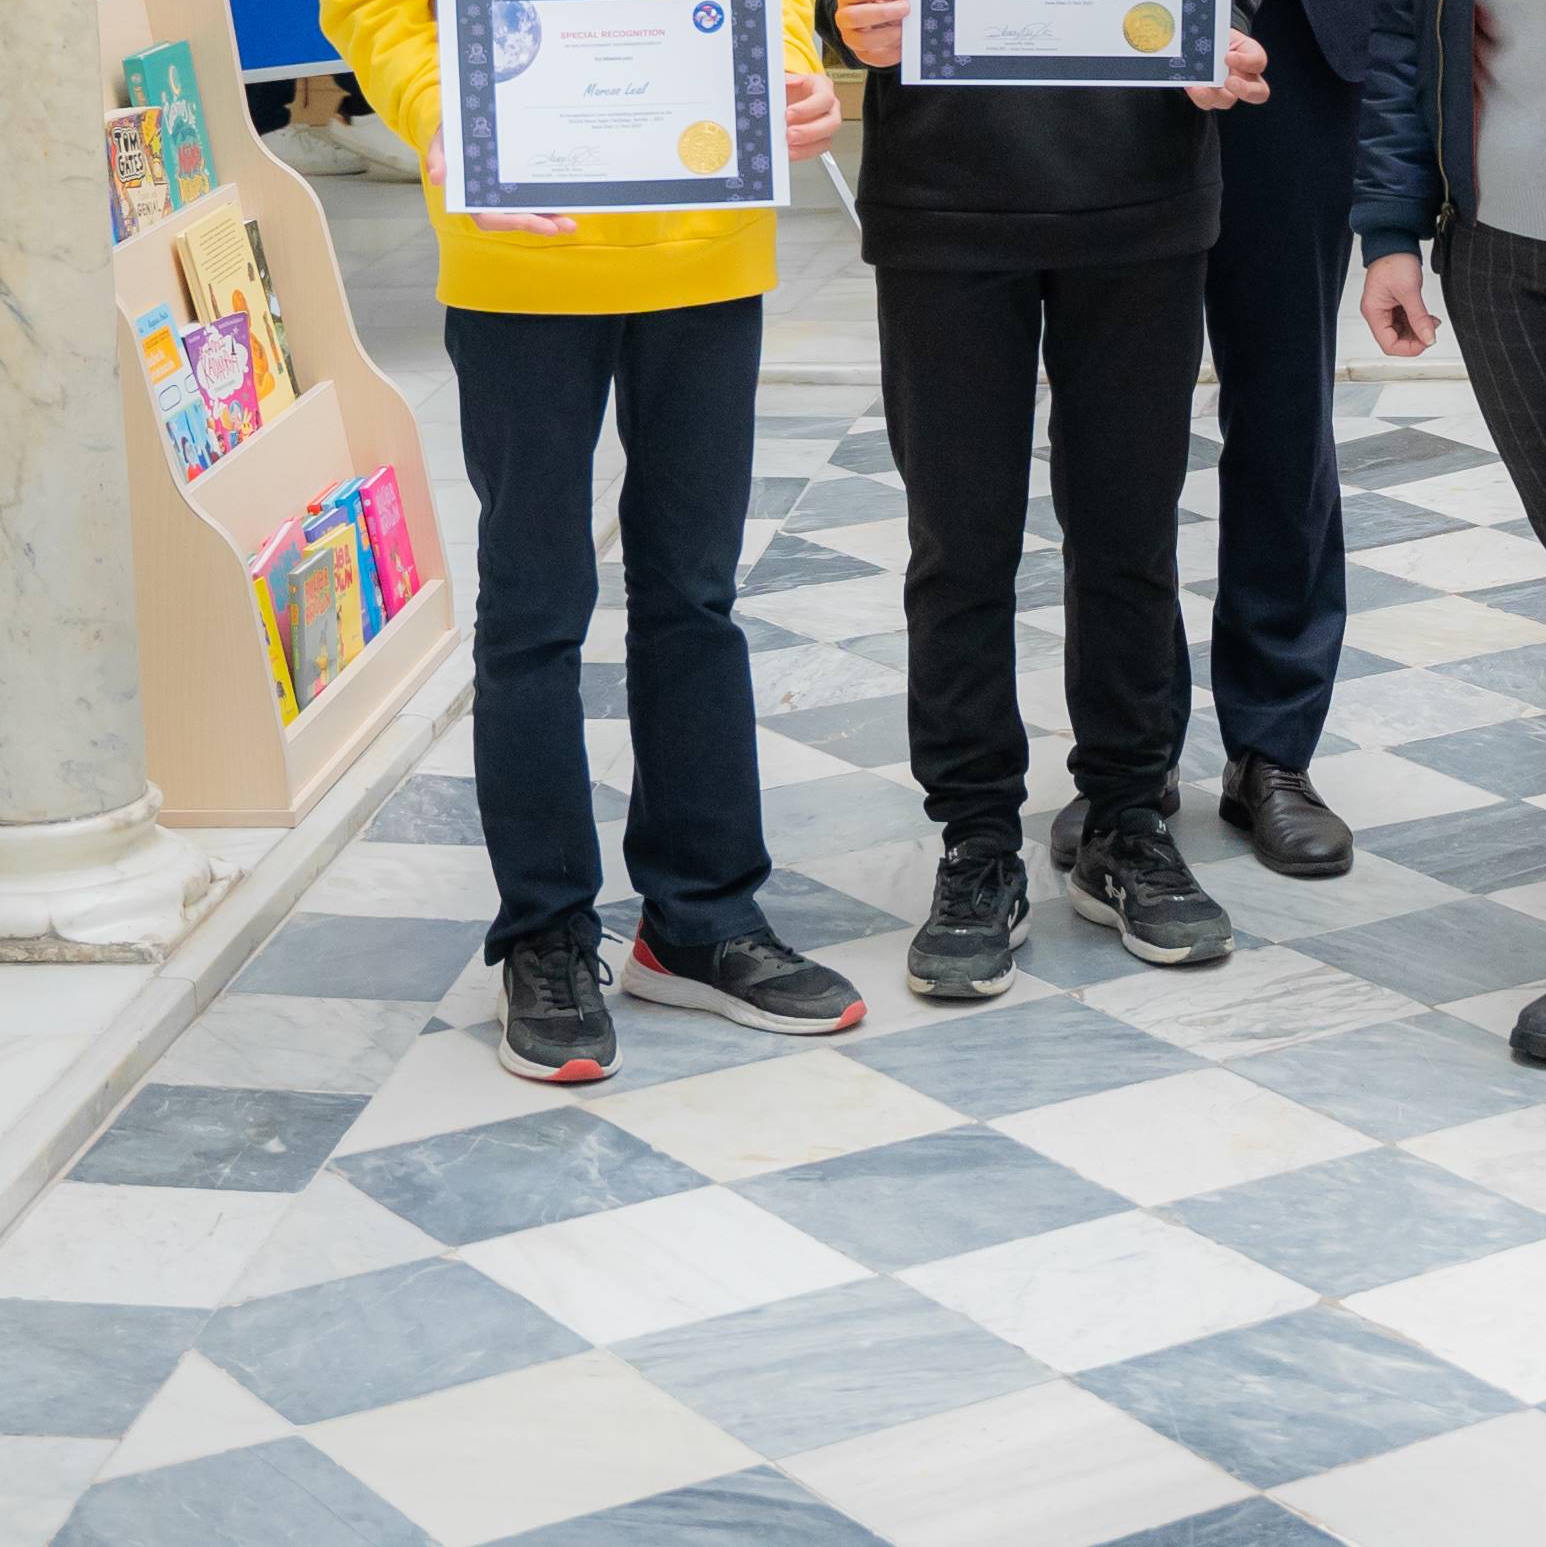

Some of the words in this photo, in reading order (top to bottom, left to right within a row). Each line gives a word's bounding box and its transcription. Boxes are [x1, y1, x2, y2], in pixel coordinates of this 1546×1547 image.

[560, 31, 598, 40] SPECIAL
[601, 29, 666, 38] RECOGNITION
[113, 130, 139, 153] TOM
[118, 153, 145, 178] GATES
